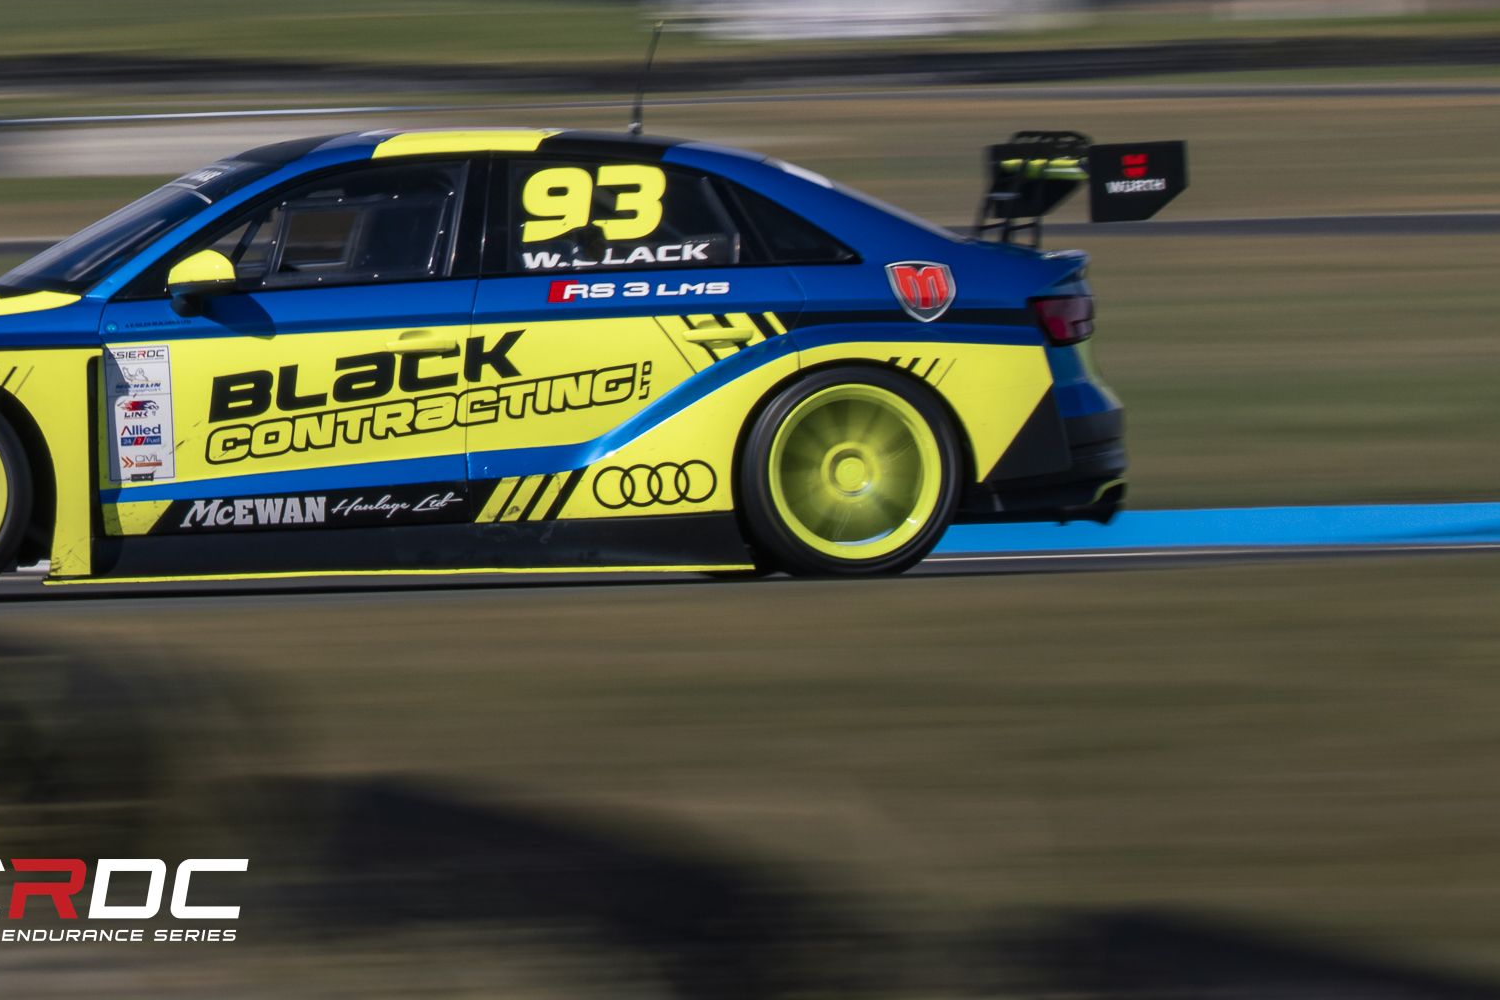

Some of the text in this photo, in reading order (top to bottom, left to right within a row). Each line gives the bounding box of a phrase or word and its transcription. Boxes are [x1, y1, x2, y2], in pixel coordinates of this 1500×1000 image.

[522, 164, 667, 243] 93
[563, 281, 730, 300] RS 3 LMS
[638, 360, 653, 401] LTD
[121, 423, 162, 437] Allied
[180, 491, 463, 528] McEWAN Haulage Ltd
